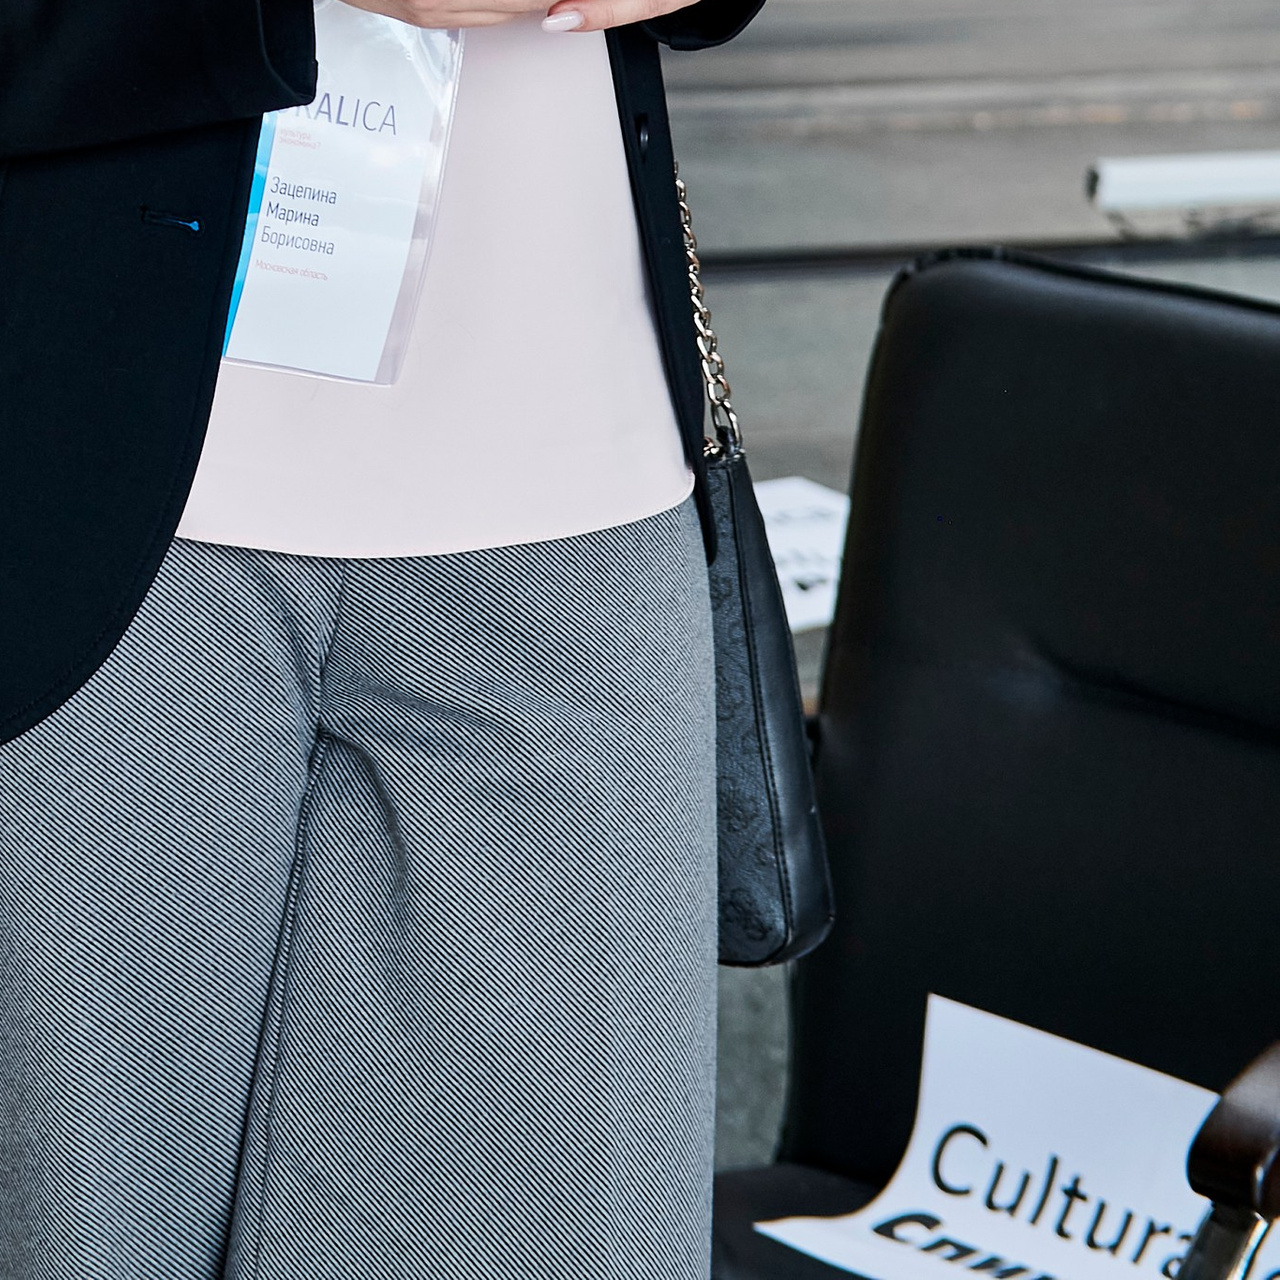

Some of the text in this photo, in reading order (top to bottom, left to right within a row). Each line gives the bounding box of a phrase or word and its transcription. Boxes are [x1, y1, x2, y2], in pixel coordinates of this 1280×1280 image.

[279, 92, 397, 136] ALICA
[270, 176, 338, 205] Зацепина
[266, 201, 320, 227] Марина
[261, 225, 335, 255] Борисовна
